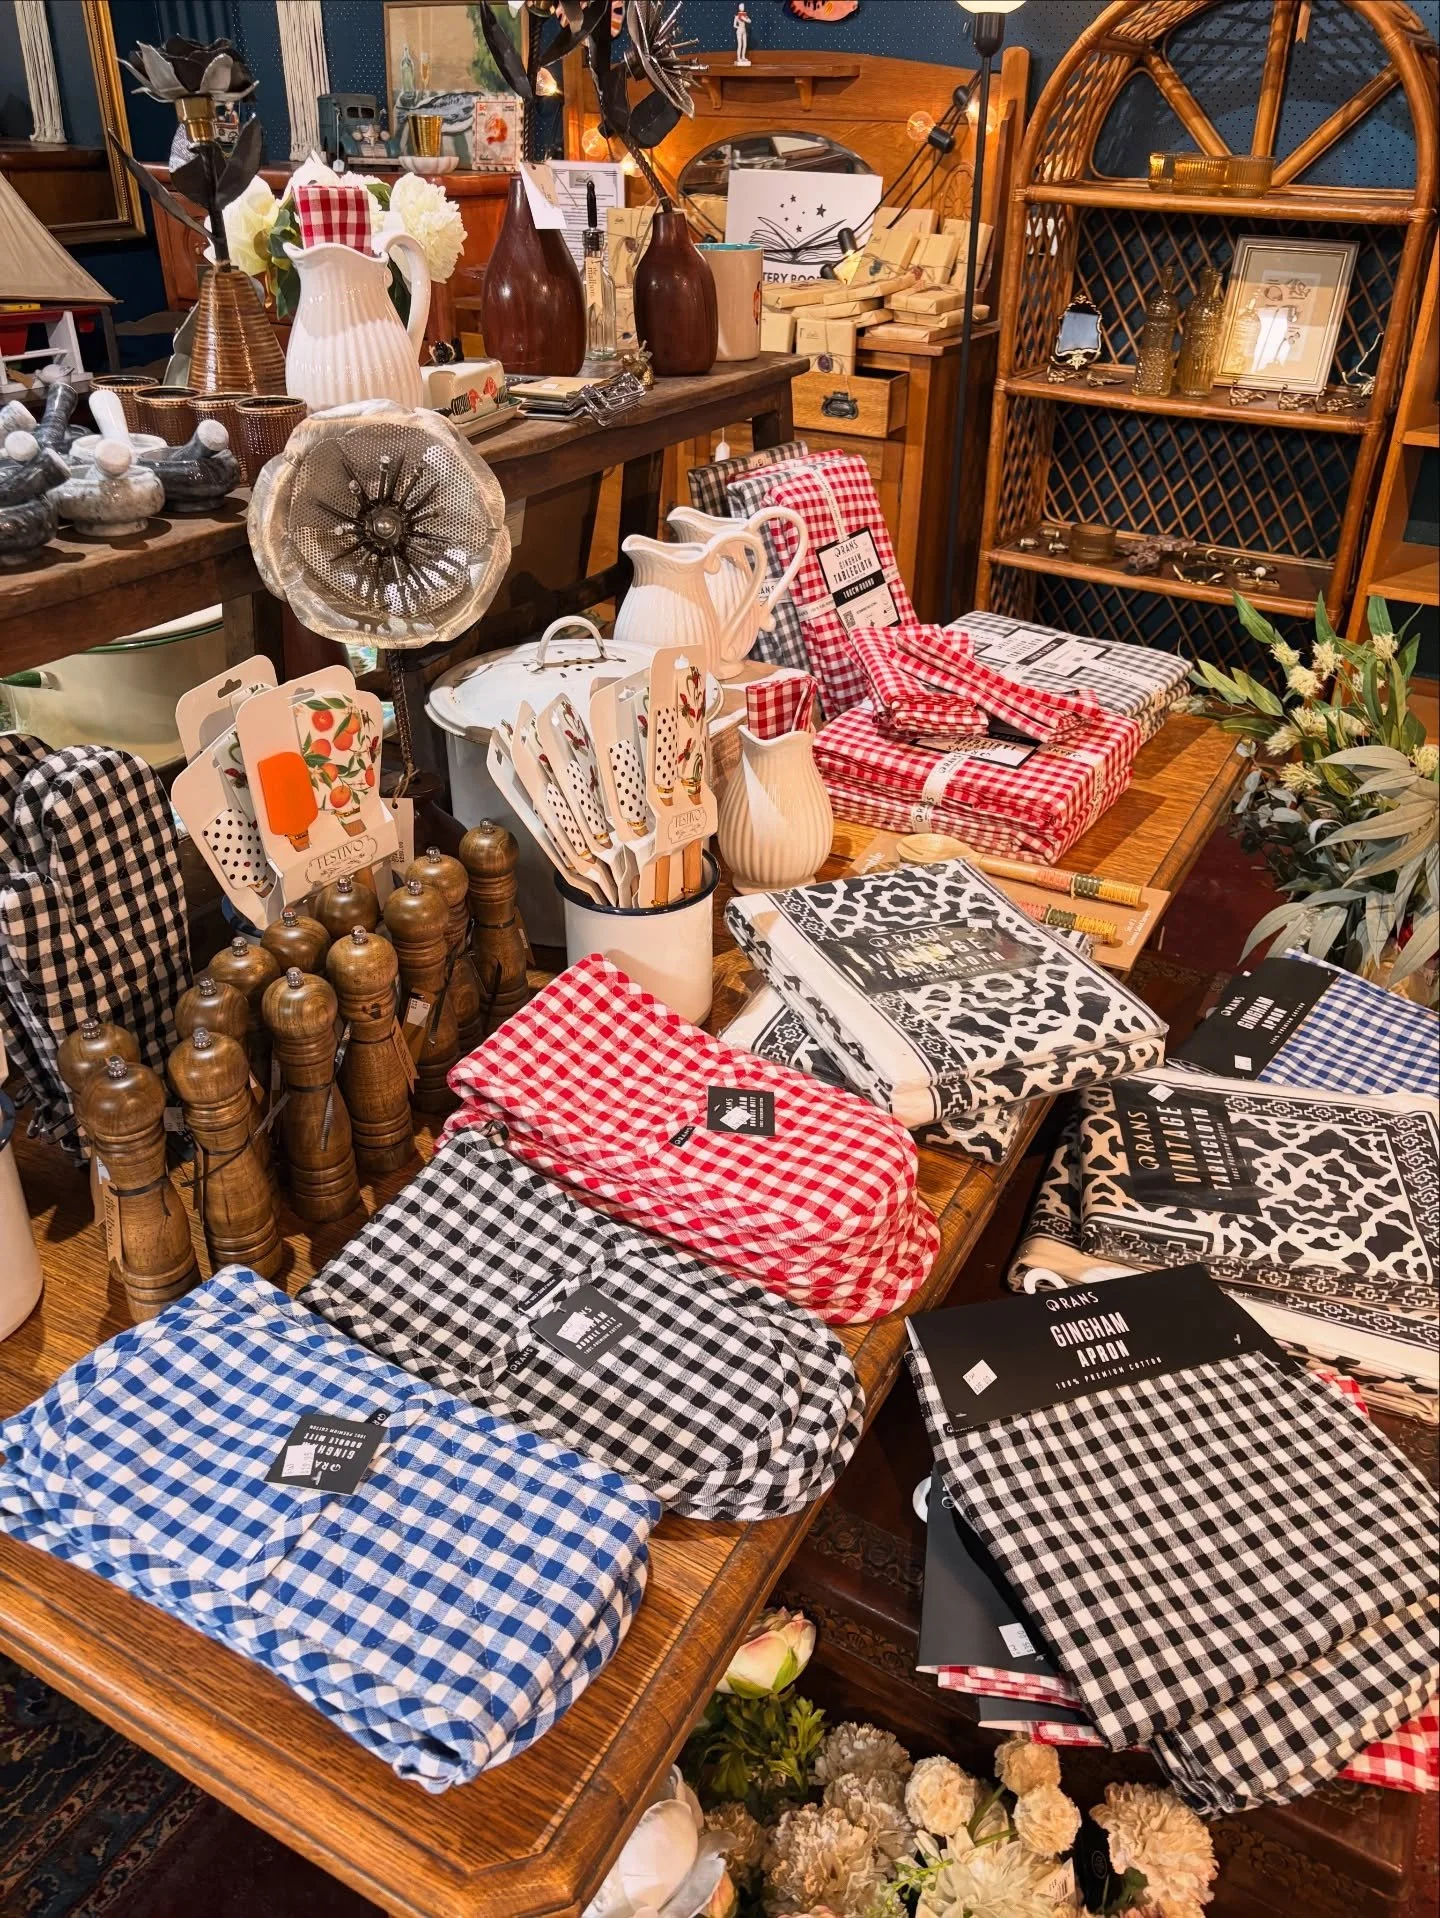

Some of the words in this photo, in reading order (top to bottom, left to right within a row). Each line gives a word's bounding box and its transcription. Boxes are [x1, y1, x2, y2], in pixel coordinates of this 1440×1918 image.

[1237, 996, 1275, 1030] GINGHAM
[1261, 1007, 1288, 1030] APRON
[1156, 1105, 1202, 1183] VINTAGE
[1190, 1107, 1233, 1191] TABLECLOTH
[575, 1331, 601, 1350] DOUBLE
[599, 1316, 617, 1332] MITT
[1049, 1311, 1130, 1347] GINGHAM
[1076, 1339, 1130, 1368] APRON
[1055, 1378, 1080, 1390] 100%
[1084, 1366, 1125, 1383] PREMIUM
[1128, 1356, 1162, 1371] COTTON
[303, 1432, 326, 1442] MITT
[328, 1436, 363, 1449] DOUBLE
